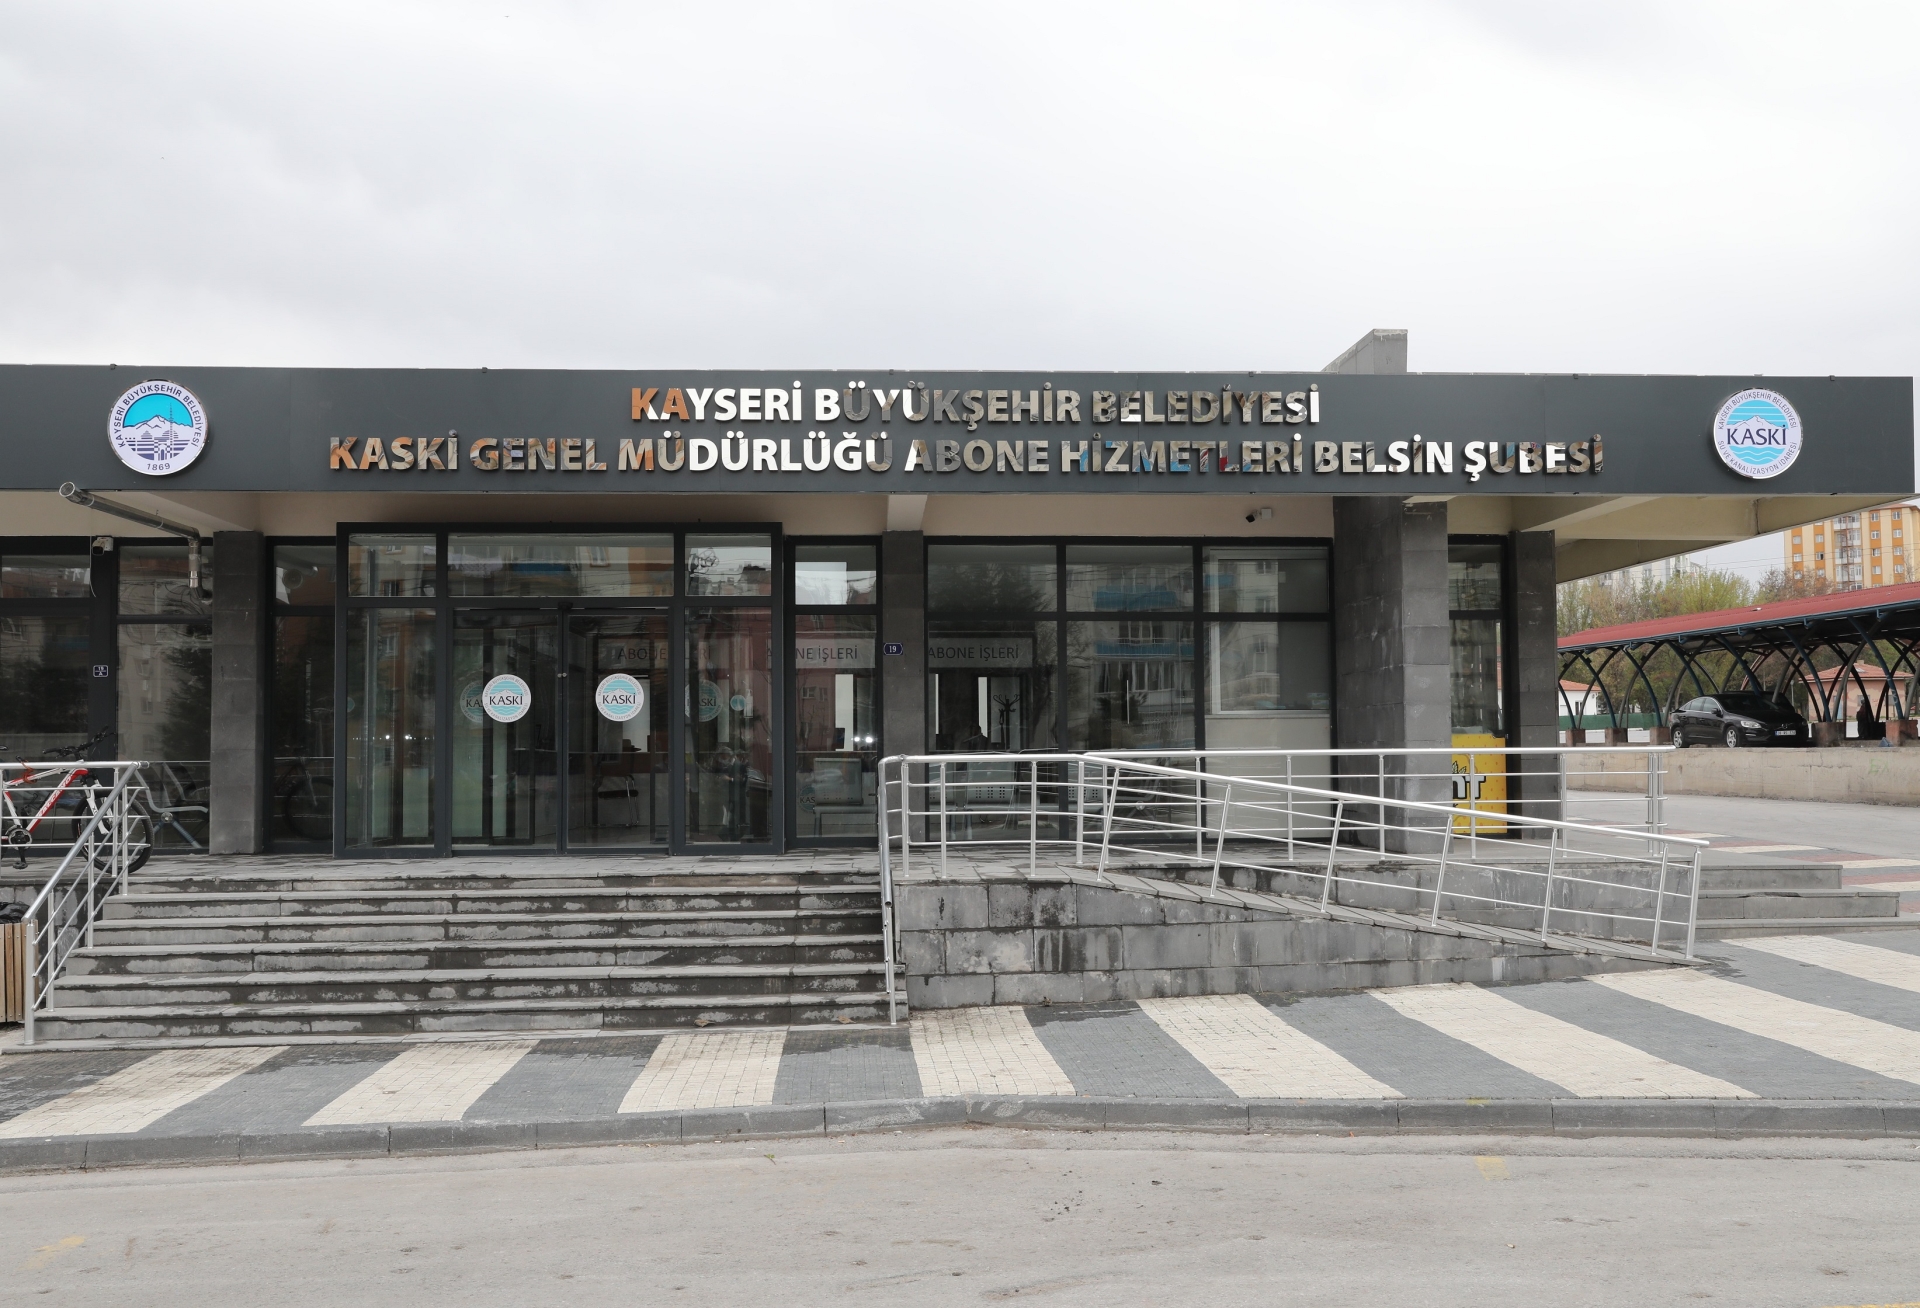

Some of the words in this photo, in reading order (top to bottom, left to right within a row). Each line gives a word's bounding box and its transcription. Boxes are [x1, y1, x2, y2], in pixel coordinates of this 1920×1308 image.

[631, 380, 802, 421] KAYSERİ
[815, 381, 1081, 431] BÜYÜKŞEHİR
[1092, 383, 1320, 423] BELEDİYESİ
[1731, 391, 1772, 406] BÜYÜKŞEHİR
[114, 406, 126, 448] KAYSERİ
[123, 384, 182, 406] BÜYÜKŞEHİR
[183, 395, 204, 448] BELEDİYESİ
[1727, 424, 1787, 445] KASKİ
[330, 429, 458, 470] KASKİ
[470, 437, 607, 471] GENEL
[618, 430, 893, 471] MÜDÜRLÜĞÜ
[904, 439, 1049, 472] ABONE
[1061, 432, 1302, 473] HİZMETLERİ
[1314, 434, 1453, 473] BELSİN
[1464, 434, 1603, 482] ŞUBESİ
[1718, 440, 1725, 450] SU
[1722, 450, 1731, 459] VE
[147, 462, 171, 471] 1869
[818, 645, 858, 662] İŞLERİ
[889, 645, 897, 653] 19
[928, 646, 974, 659] ABONE
[979, 644, 1019, 661] İŞLERİ
[489, 693, 523, 706] KASKİ
[602, 692, 636, 705] KASKİ
